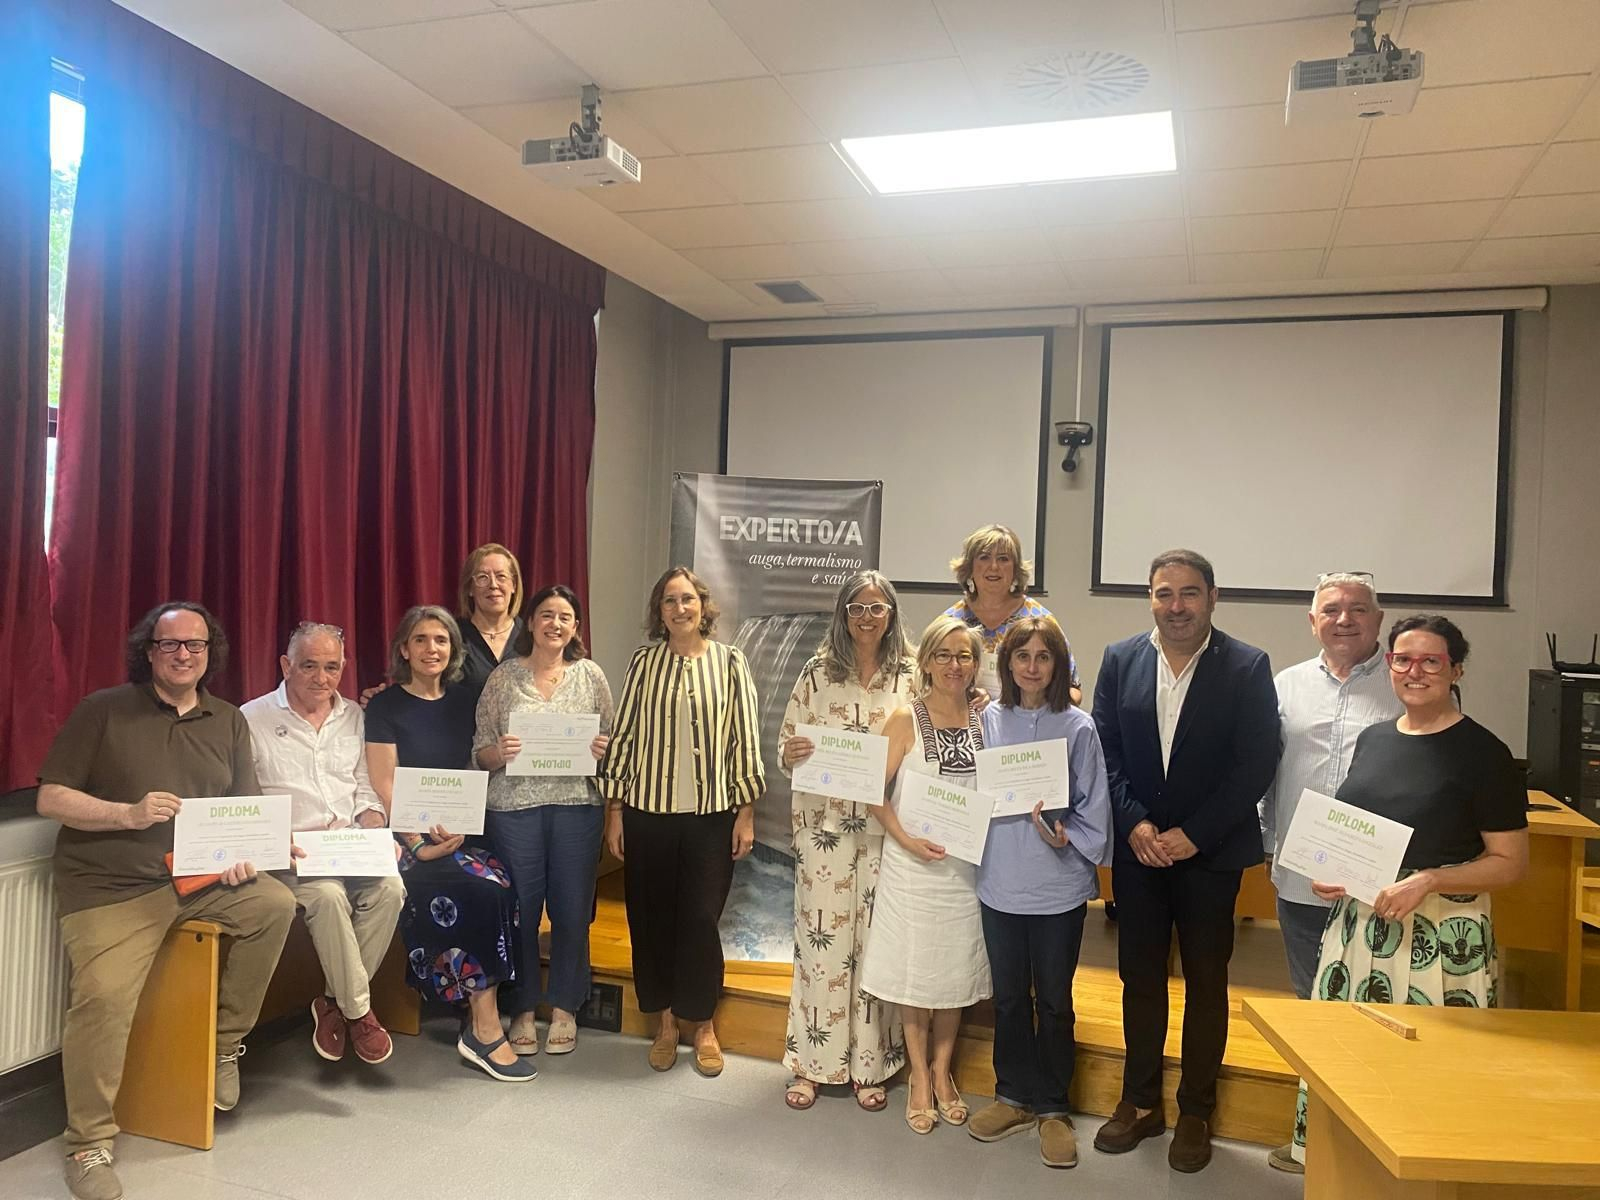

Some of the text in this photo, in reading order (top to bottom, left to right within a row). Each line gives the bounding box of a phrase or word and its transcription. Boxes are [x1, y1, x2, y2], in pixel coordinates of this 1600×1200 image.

[719, 516, 864, 546] EXPERTO/A
[812, 575, 818, 584] e
[821, 735, 862, 752] DIPLOMA
[532, 760, 571, 768] DIPLOMA
[1001, 750, 1041, 765] DIPLOMA
[421, 776, 462, 787] DIPLOMA
[928, 785, 967, 807] DIPLOMA
[210, 805, 260, 817] DIPLOMA
[1328, 809, 1376, 837] DIPLOMA
[323, 834, 366, 842] DIPLOMA
